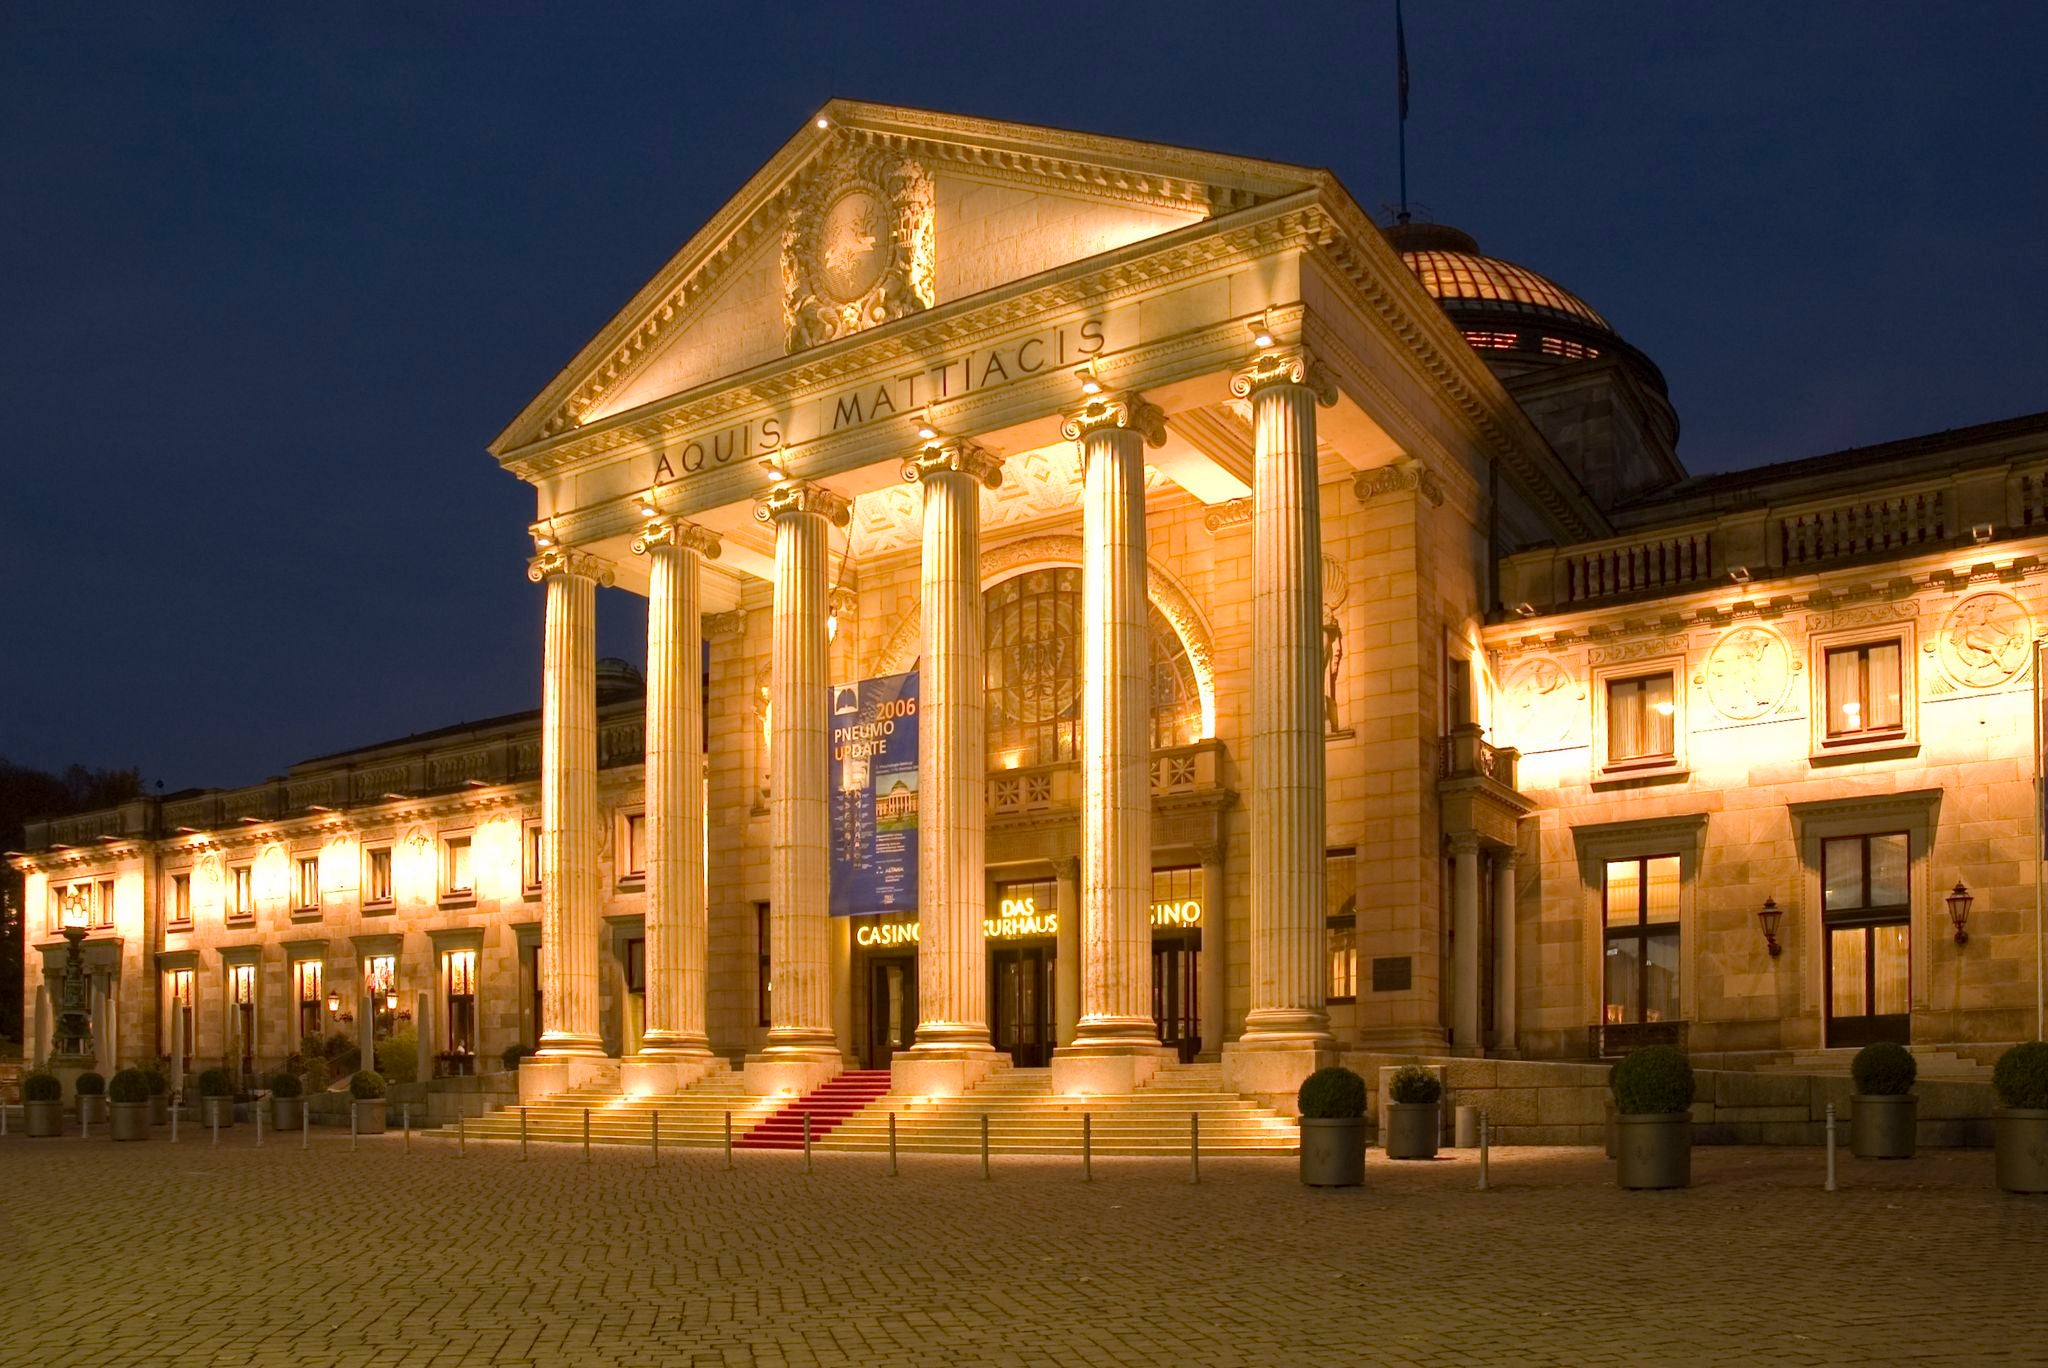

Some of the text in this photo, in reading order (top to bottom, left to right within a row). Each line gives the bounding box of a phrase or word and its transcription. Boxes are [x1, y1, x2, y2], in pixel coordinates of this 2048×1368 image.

[653, 320, 1106, 483] AQUIS MATTIACIS
[876, 697, 916, 720] 2006
[834, 720, 894, 743] PNEUMO
[834, 739, 887, 760] UPDATE
[1002, 898, 1034, 917] DAS
